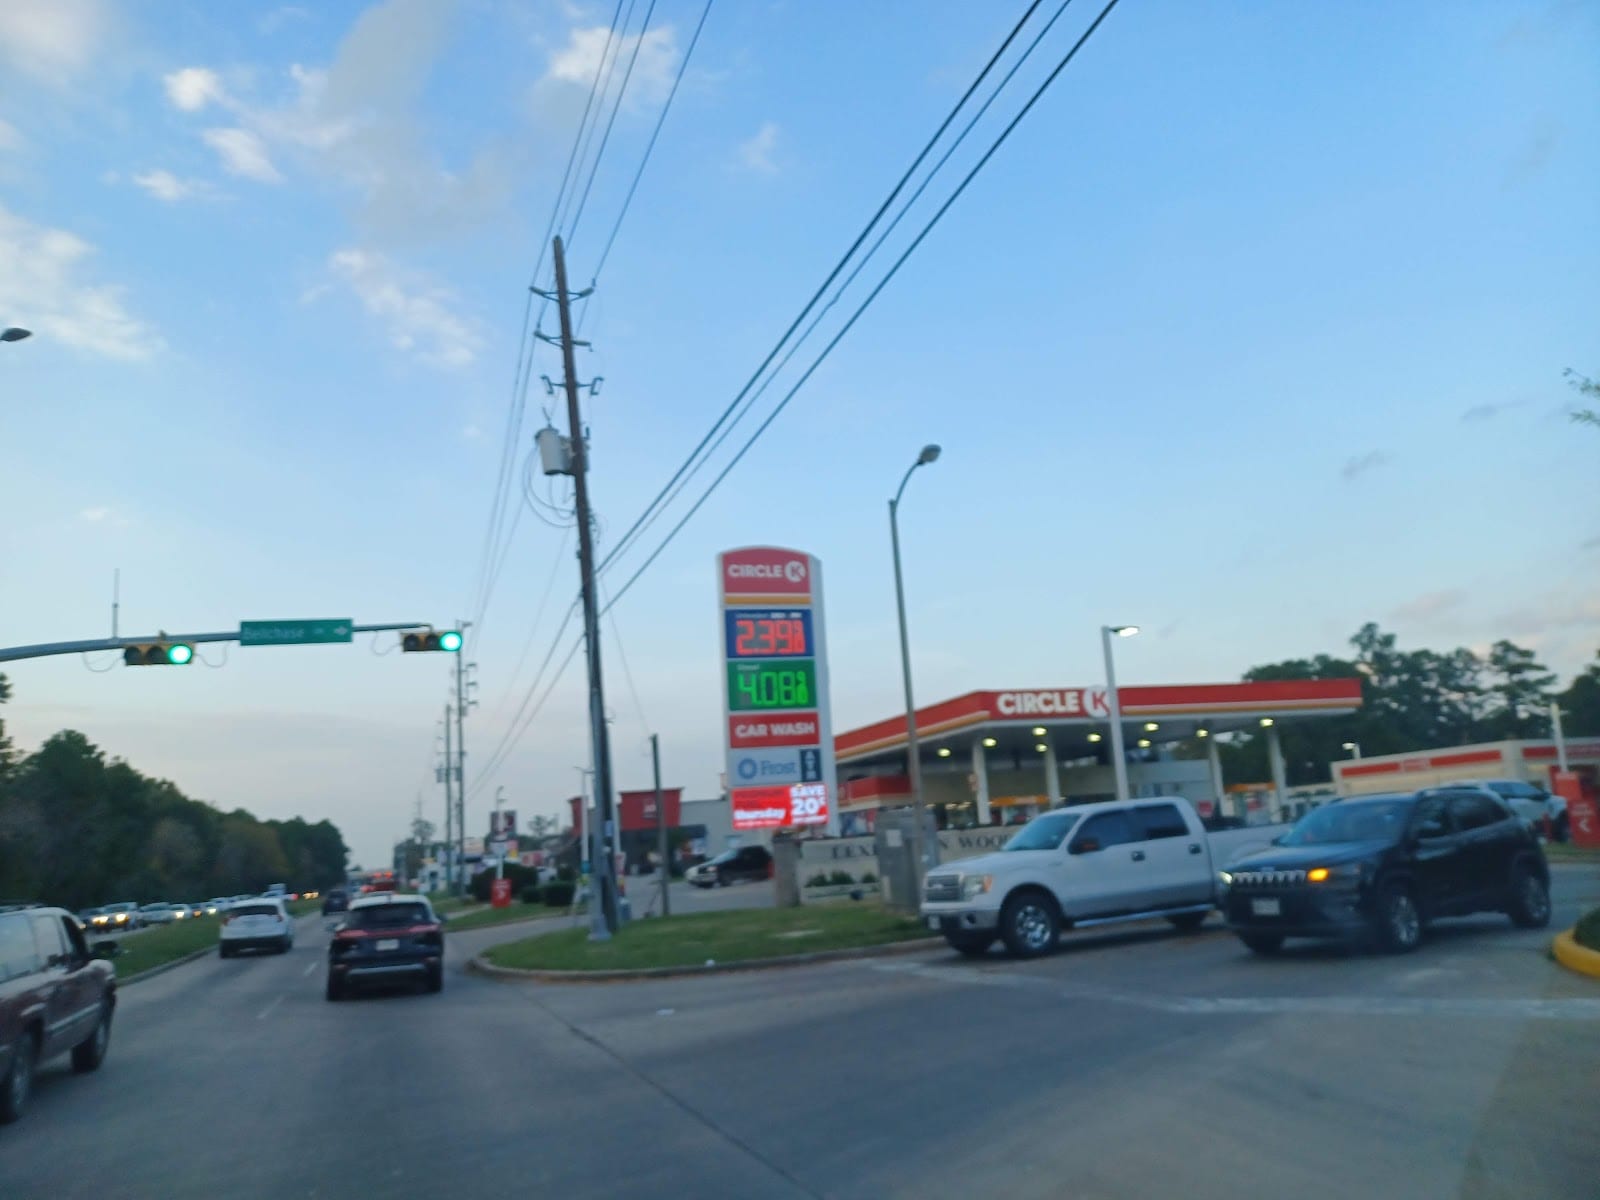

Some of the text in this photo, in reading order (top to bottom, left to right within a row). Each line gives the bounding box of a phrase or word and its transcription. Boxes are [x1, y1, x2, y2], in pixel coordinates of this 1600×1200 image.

[728, 561, 806, 582] CIRCLE K
[997, 687, 1111, 717] CIRCLE K
[735, 722, 815, 738] CAR WASH
